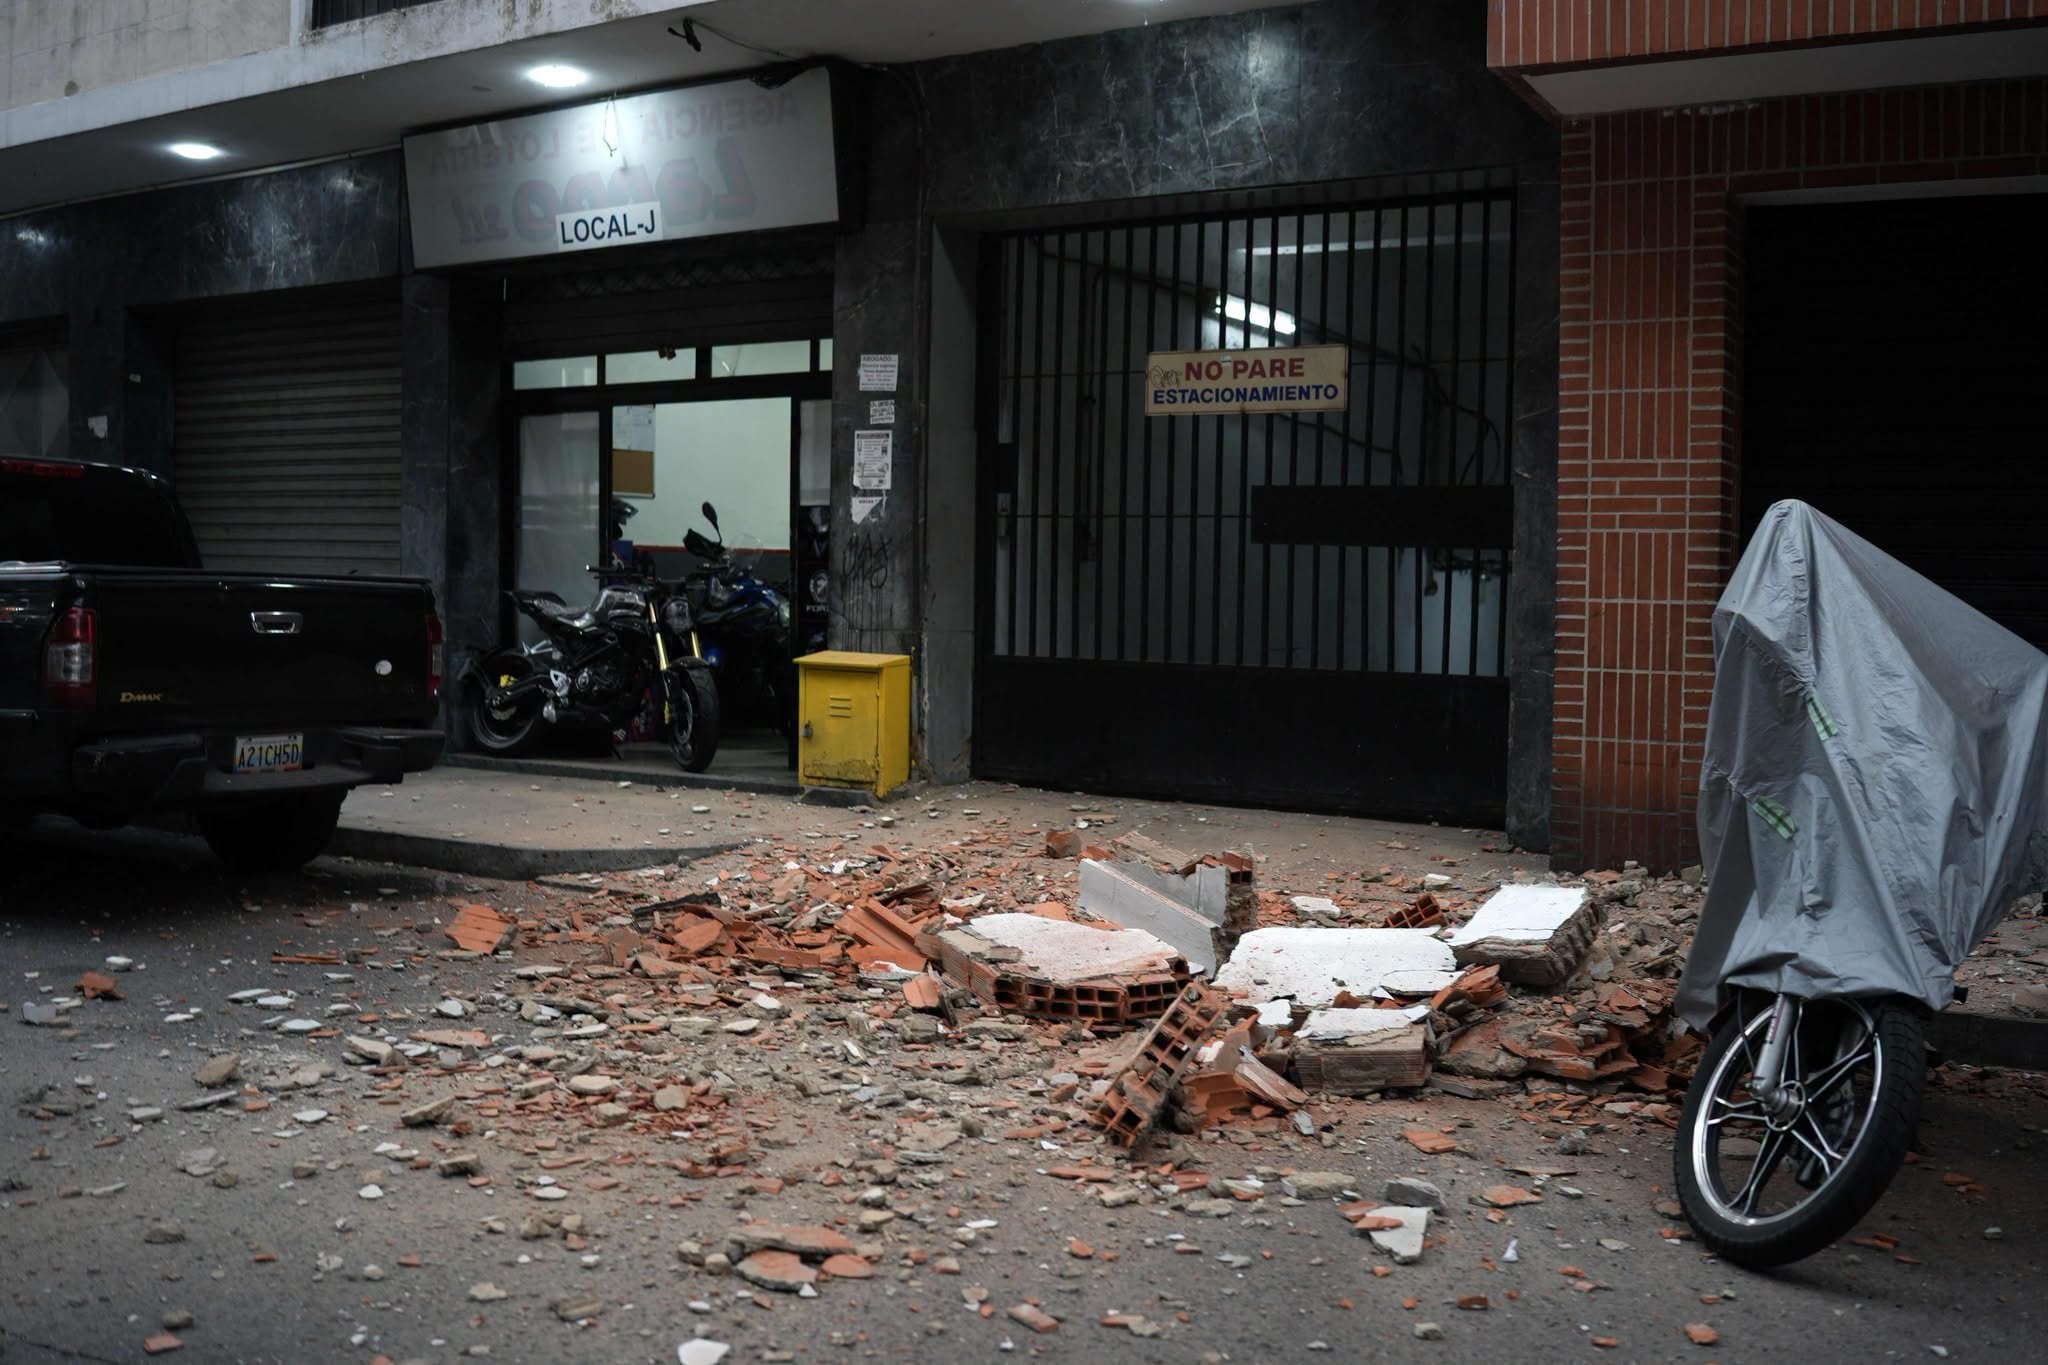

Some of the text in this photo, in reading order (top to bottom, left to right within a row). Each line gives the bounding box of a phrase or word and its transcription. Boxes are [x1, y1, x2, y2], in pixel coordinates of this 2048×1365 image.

[561, 209, 656, 246] LOCAL-J
[1185, 360, 1223, 381] NO
[1232, 358, 1305, 379] PARE
[1153, 384, 1339, 404] ESTACIONAMIENTO
[238, 743, 300, 770] A21CH5D
